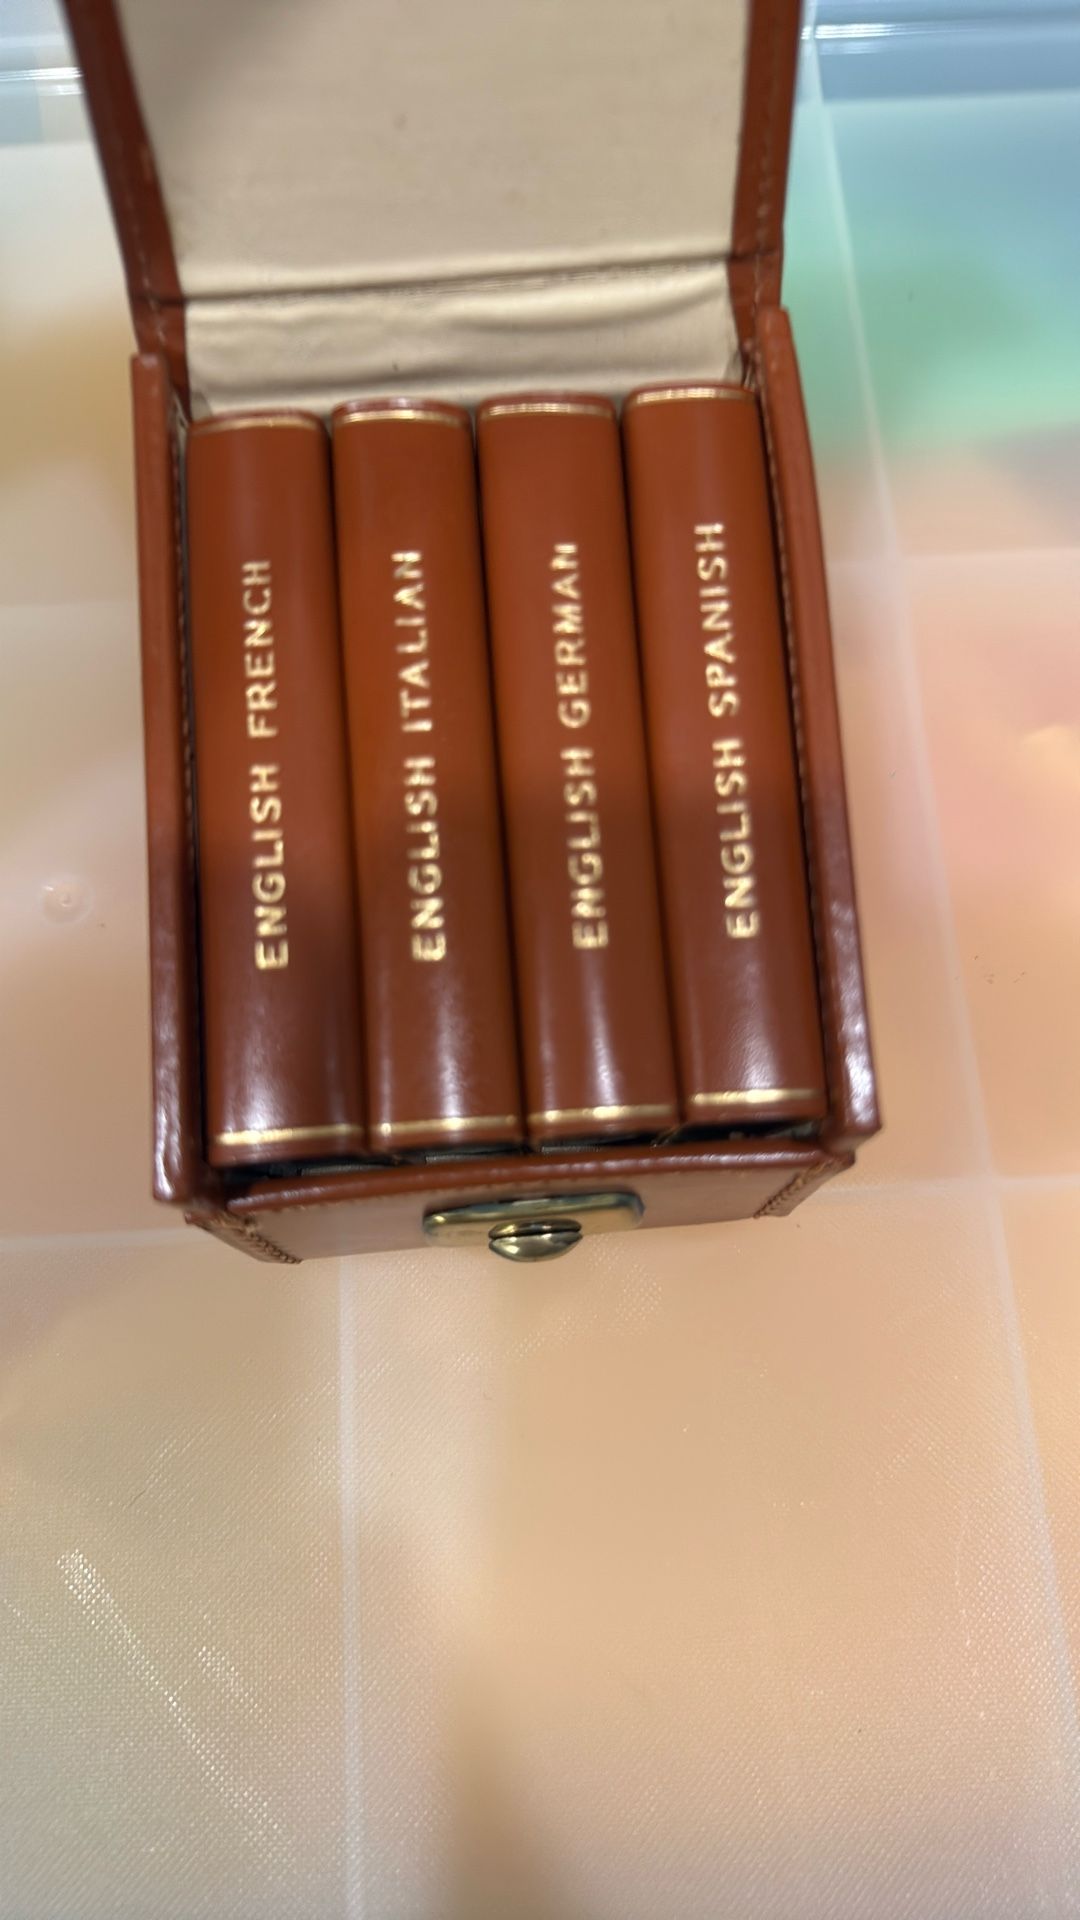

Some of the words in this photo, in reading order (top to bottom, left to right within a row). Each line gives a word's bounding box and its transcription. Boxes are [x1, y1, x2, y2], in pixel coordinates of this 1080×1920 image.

[242, 560, 277, 738] FRENCH
[391, 550, 433, 732] ITALIAN
[550, 542, 591, 729] GERMAN
[694, 522, 740, 718] SPANISH
[250, 764, 289, 970] ENGLISH
[404, 756, 447, 962] ENGLISH
[560, 747, 609, 949] ENGLISH
[712, 737, 760, 939] ENGLISH
